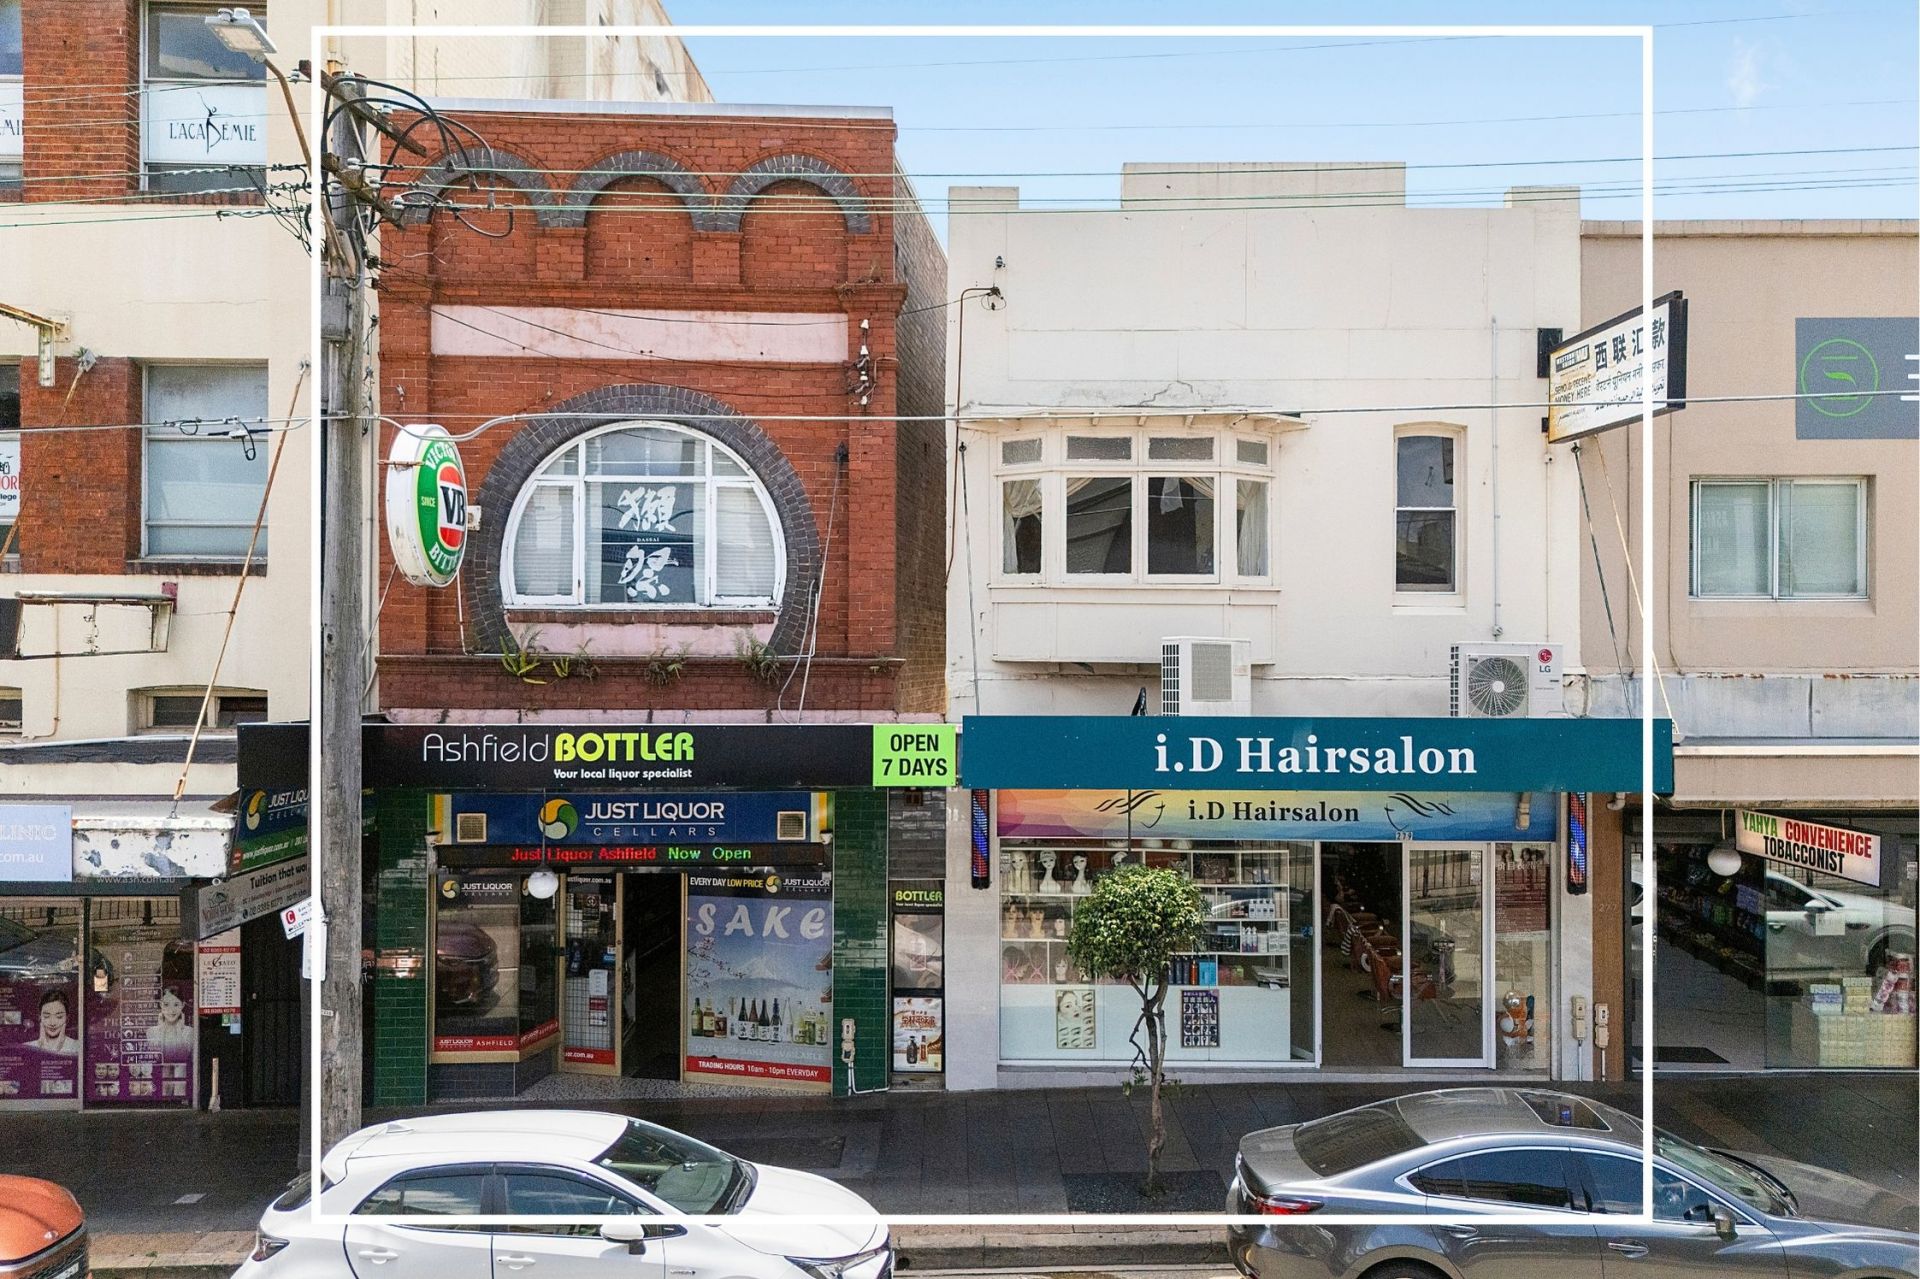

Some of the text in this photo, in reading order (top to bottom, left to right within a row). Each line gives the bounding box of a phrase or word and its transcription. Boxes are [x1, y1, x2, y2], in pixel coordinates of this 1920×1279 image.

[1576, 385, 1591, 399] HERE
[440, 486, 466, 525] VB
[1539, 665, 1551, 673] LG
[423, 732, 695, 763] Ashfield BOTTLER
[890, 734, 939, 752] OPEN
[1154, 733, 1477, 774] i.D Hairsalon
[553, 768, 692, 780] Your local liquor specialist
[882, 758, 948, 776] 7 DAYS
[268, 791, 291, 808] JUST
[585, 802, 725, 821] JUST LIQUOR
[1188, 799, 1360, 822] i.D Hairsalon
[593, 827, 716, 837] CELLARS
[1742, 811, 1872, 858] YAHYA CONVENIENCE
[512, 847, 752, 862] Just Liquor Ashfield Now Open
[1763, 835, 1845, 873] TOBACCONIST
[250, 873, 277, 889] Tuition
[278, 867, 294, 881] that
[690, 877, 763, 888] EVERY DAY LOW PRICE
[783, 878, 830, 886] JUST LIQUOR
[895, 890, 943, 901] BOTTLER
[695, 903, 826, 939] SAKE
[698, 1061, 724, 1070] TRADING
[724, 1063, 745, 1072] HOURS
[747, 1065, 764, 1073] 10am
[769, 1067, 786, 1075] 10pm
[786, 1068, 819, 1077] EVERYDAY
